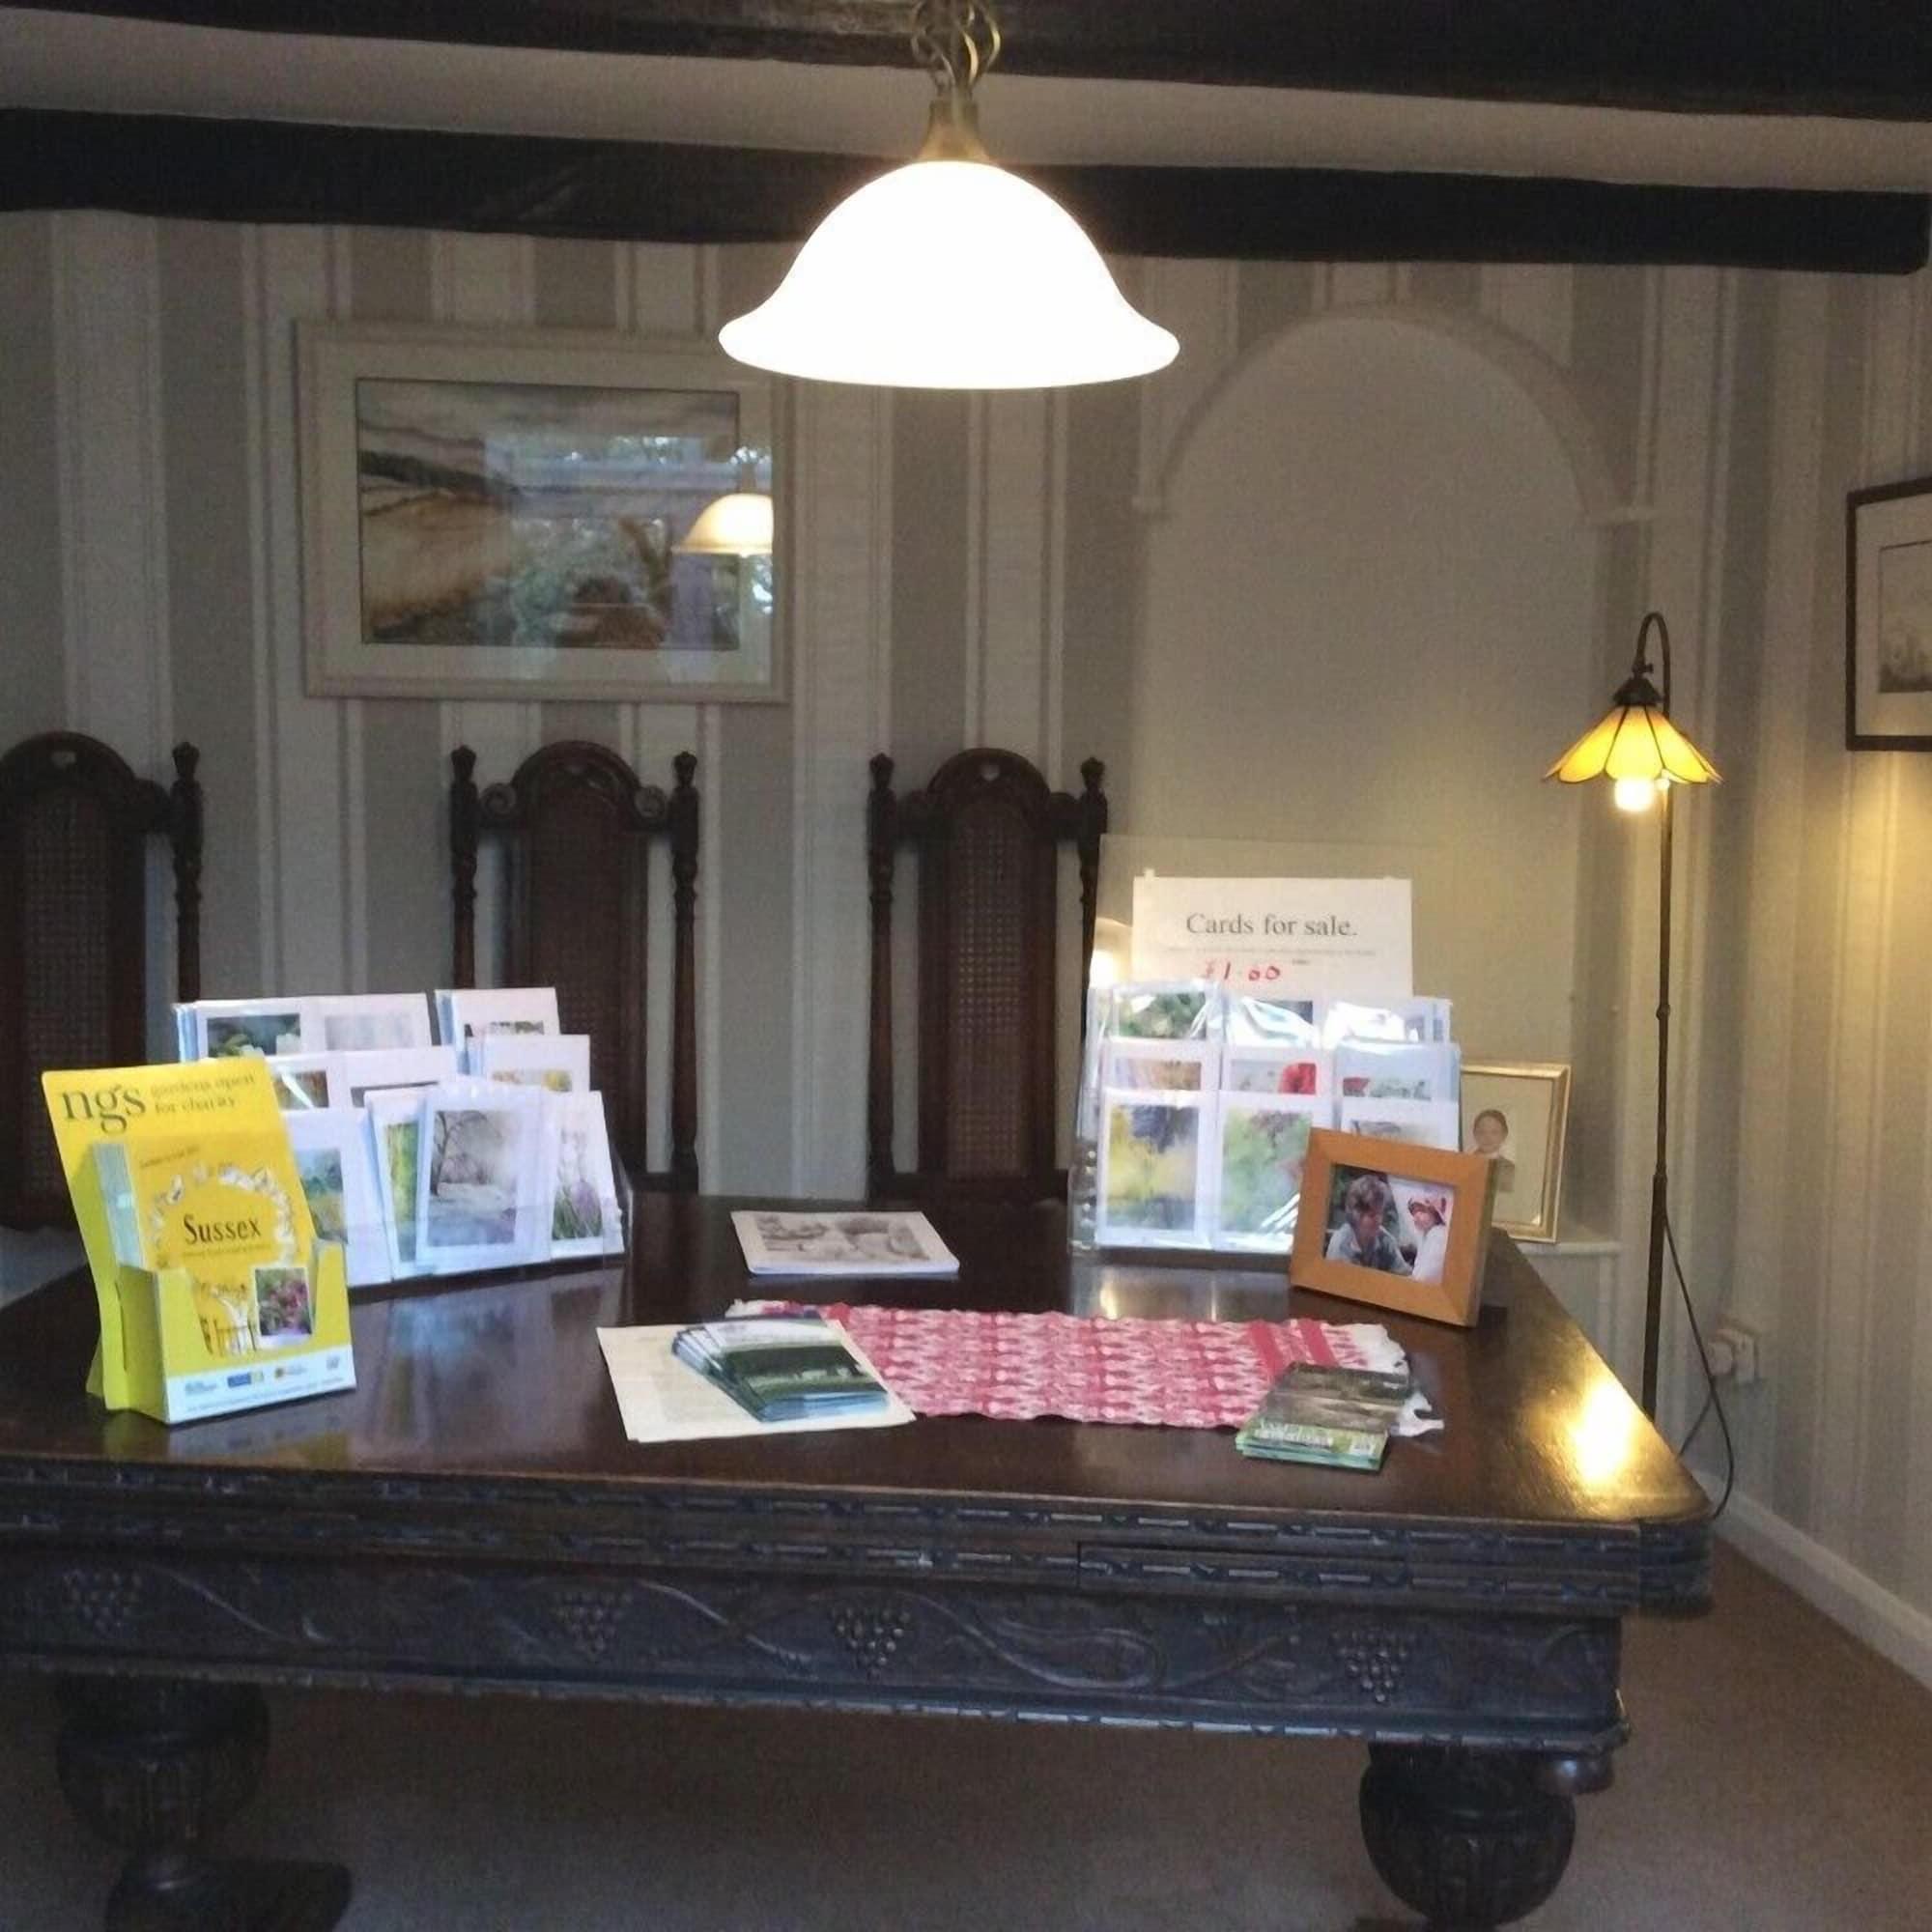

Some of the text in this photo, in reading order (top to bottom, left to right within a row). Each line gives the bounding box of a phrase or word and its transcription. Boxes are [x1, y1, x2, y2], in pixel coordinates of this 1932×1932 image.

[1185, 913, 1358, 937] Cards for sale.
[61, 1083, 146, 1136] ngs
[155, 1095, 236, 1114] for charity
[183, 1213, 262, 1246] Sussex
